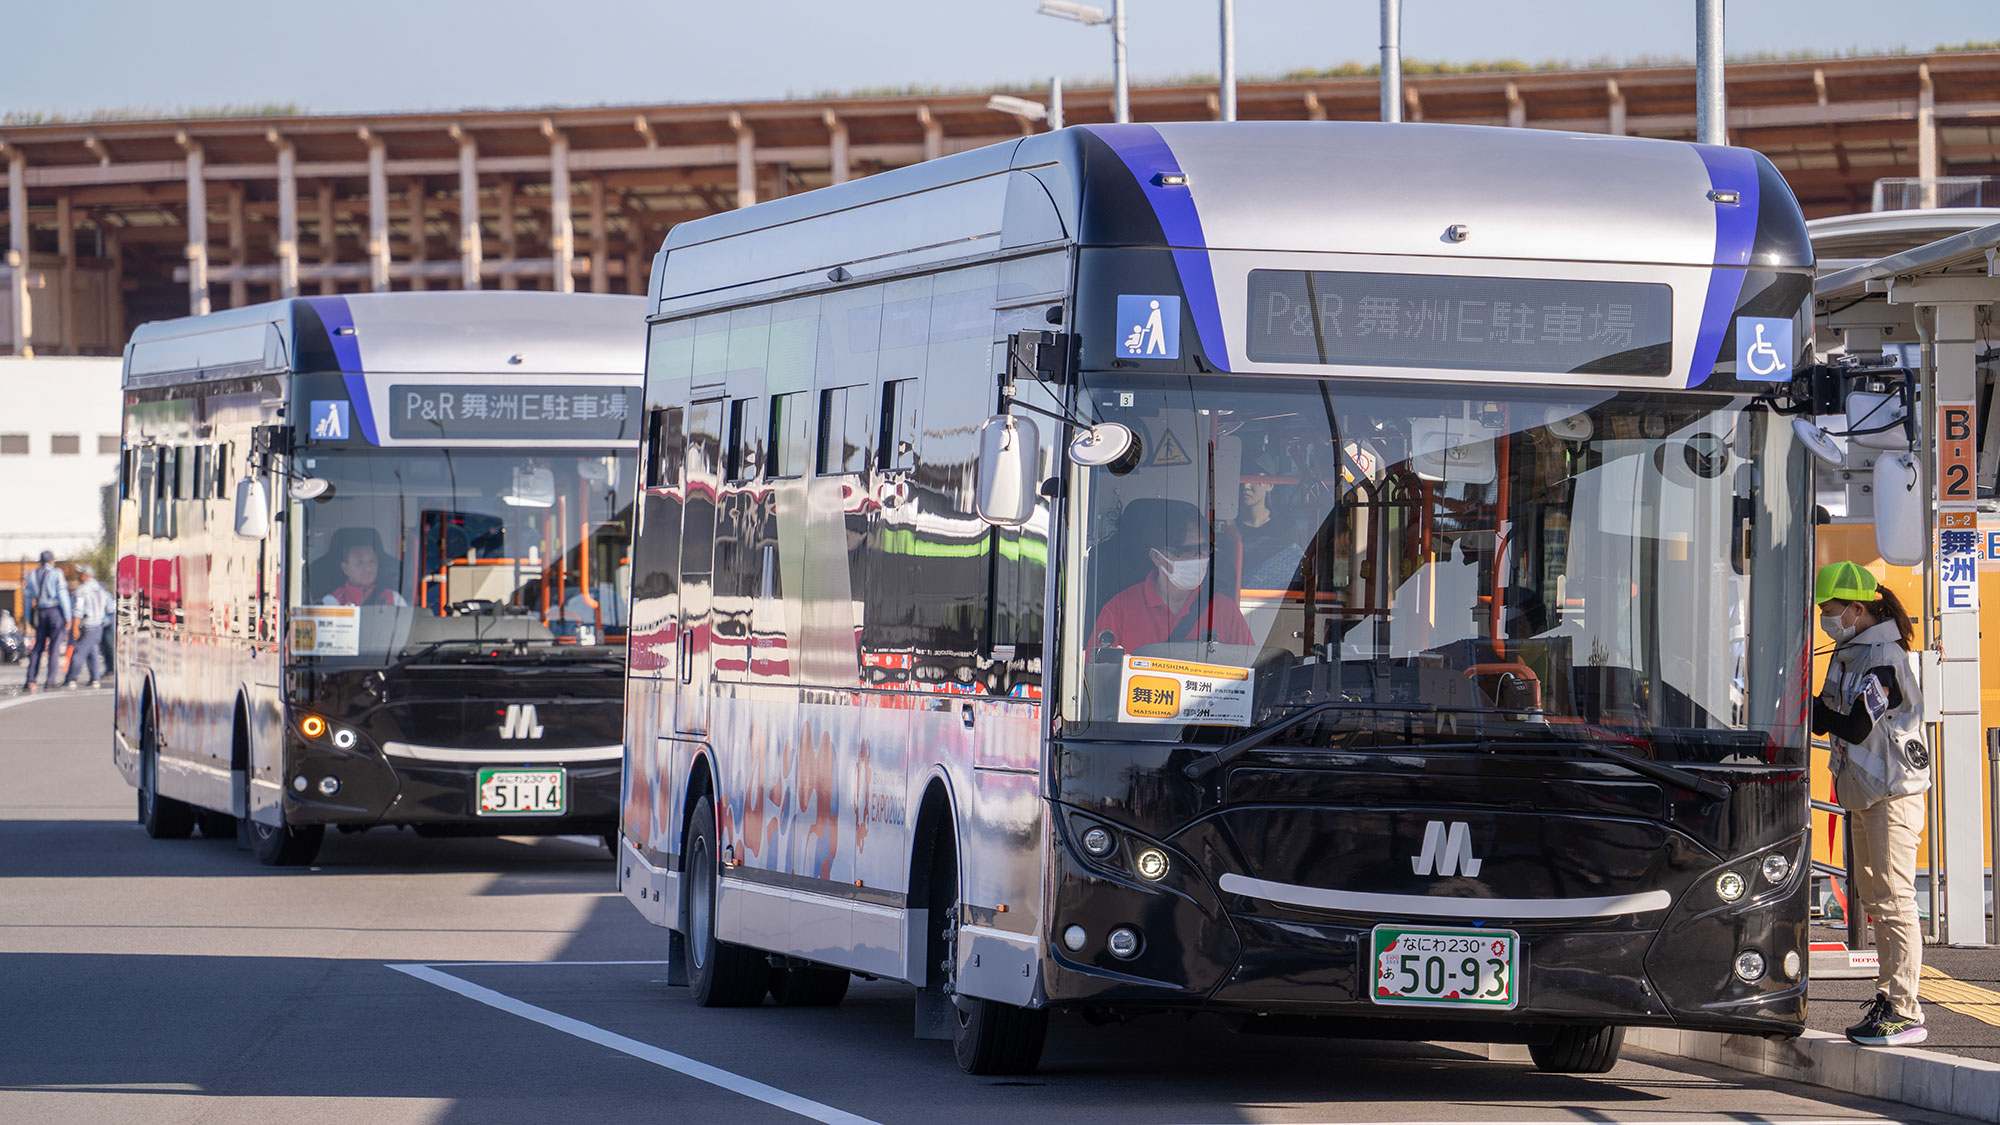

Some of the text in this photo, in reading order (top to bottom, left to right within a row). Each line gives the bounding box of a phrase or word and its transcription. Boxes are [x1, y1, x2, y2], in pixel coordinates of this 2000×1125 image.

[1267, 291, 1635, 347] P&R 舞洲E駐車場
[406, 392, 630, 421] P&R 舞洲E駐車場
[1945, 409, 1971, 495] B-2
[1945, 515, 1971, 526] B-2
[1941, 530, 1976, 608] 舞洲E
[1151, 662, 1190, 671] MAISHIMA
[1132, 686, 1174, 706] 舞洲
[1185, 680, 1212, 693] 舞洲
[495, 785, 557, 808] 51-14
[1383, 955, 1505, 997] あ 50-93
